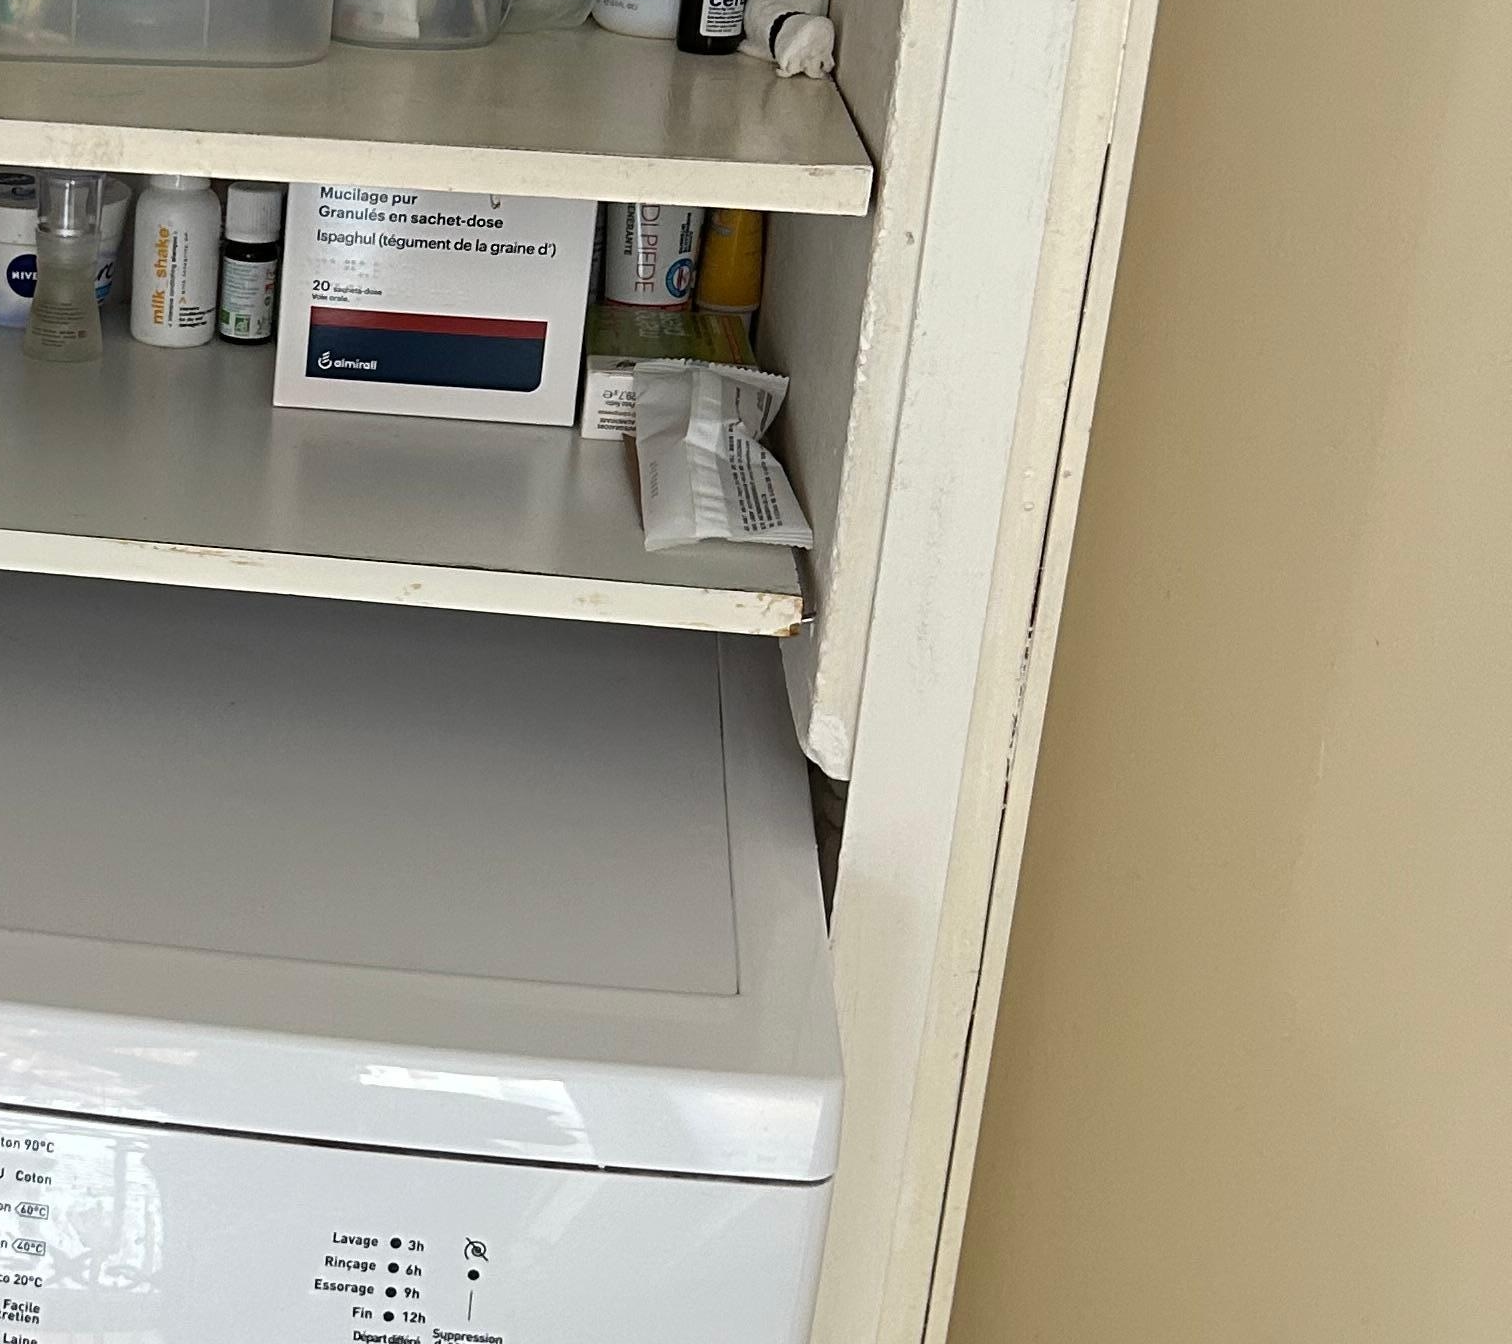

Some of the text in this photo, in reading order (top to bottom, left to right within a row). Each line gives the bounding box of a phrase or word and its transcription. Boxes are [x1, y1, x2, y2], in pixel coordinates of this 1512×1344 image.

[320, 186, 418, 206] Mucilage pur
[318, 205, 505, 229] Granulés en sachet-dose
[316, 228, 376, 247] Ispaghul
[378, 233, 451, 251] (tégument
[454, 238, 473, 252] de
[475, 239, 488, 253] la
[490, 240, 536, 257] graine
[634, 234, 659, 294] PIEDE
[151, 226, 170, 326] milk shake
[312, 279, 331, 292] 20
[333, 357, 378, 371] almirall
[24, 1138, 55, 1154] 90°C
[15, 1169, 53, 1185] Coton
[20, 1202, 47, 1218] 60°C
[16, 1240, 44, 1255] 40°C
[332, 1231, 425, 1253] Lavage 3h
[324, 1255, 423, 1278] Rinçage 6h
[13, 1273, 44, 1289] 20°C
[314, 1278, 421, 1300] Essorage 9h
[3, 1298, 41, 1314] Facile
[351, 1306, 427, 1325] Fin 12h
